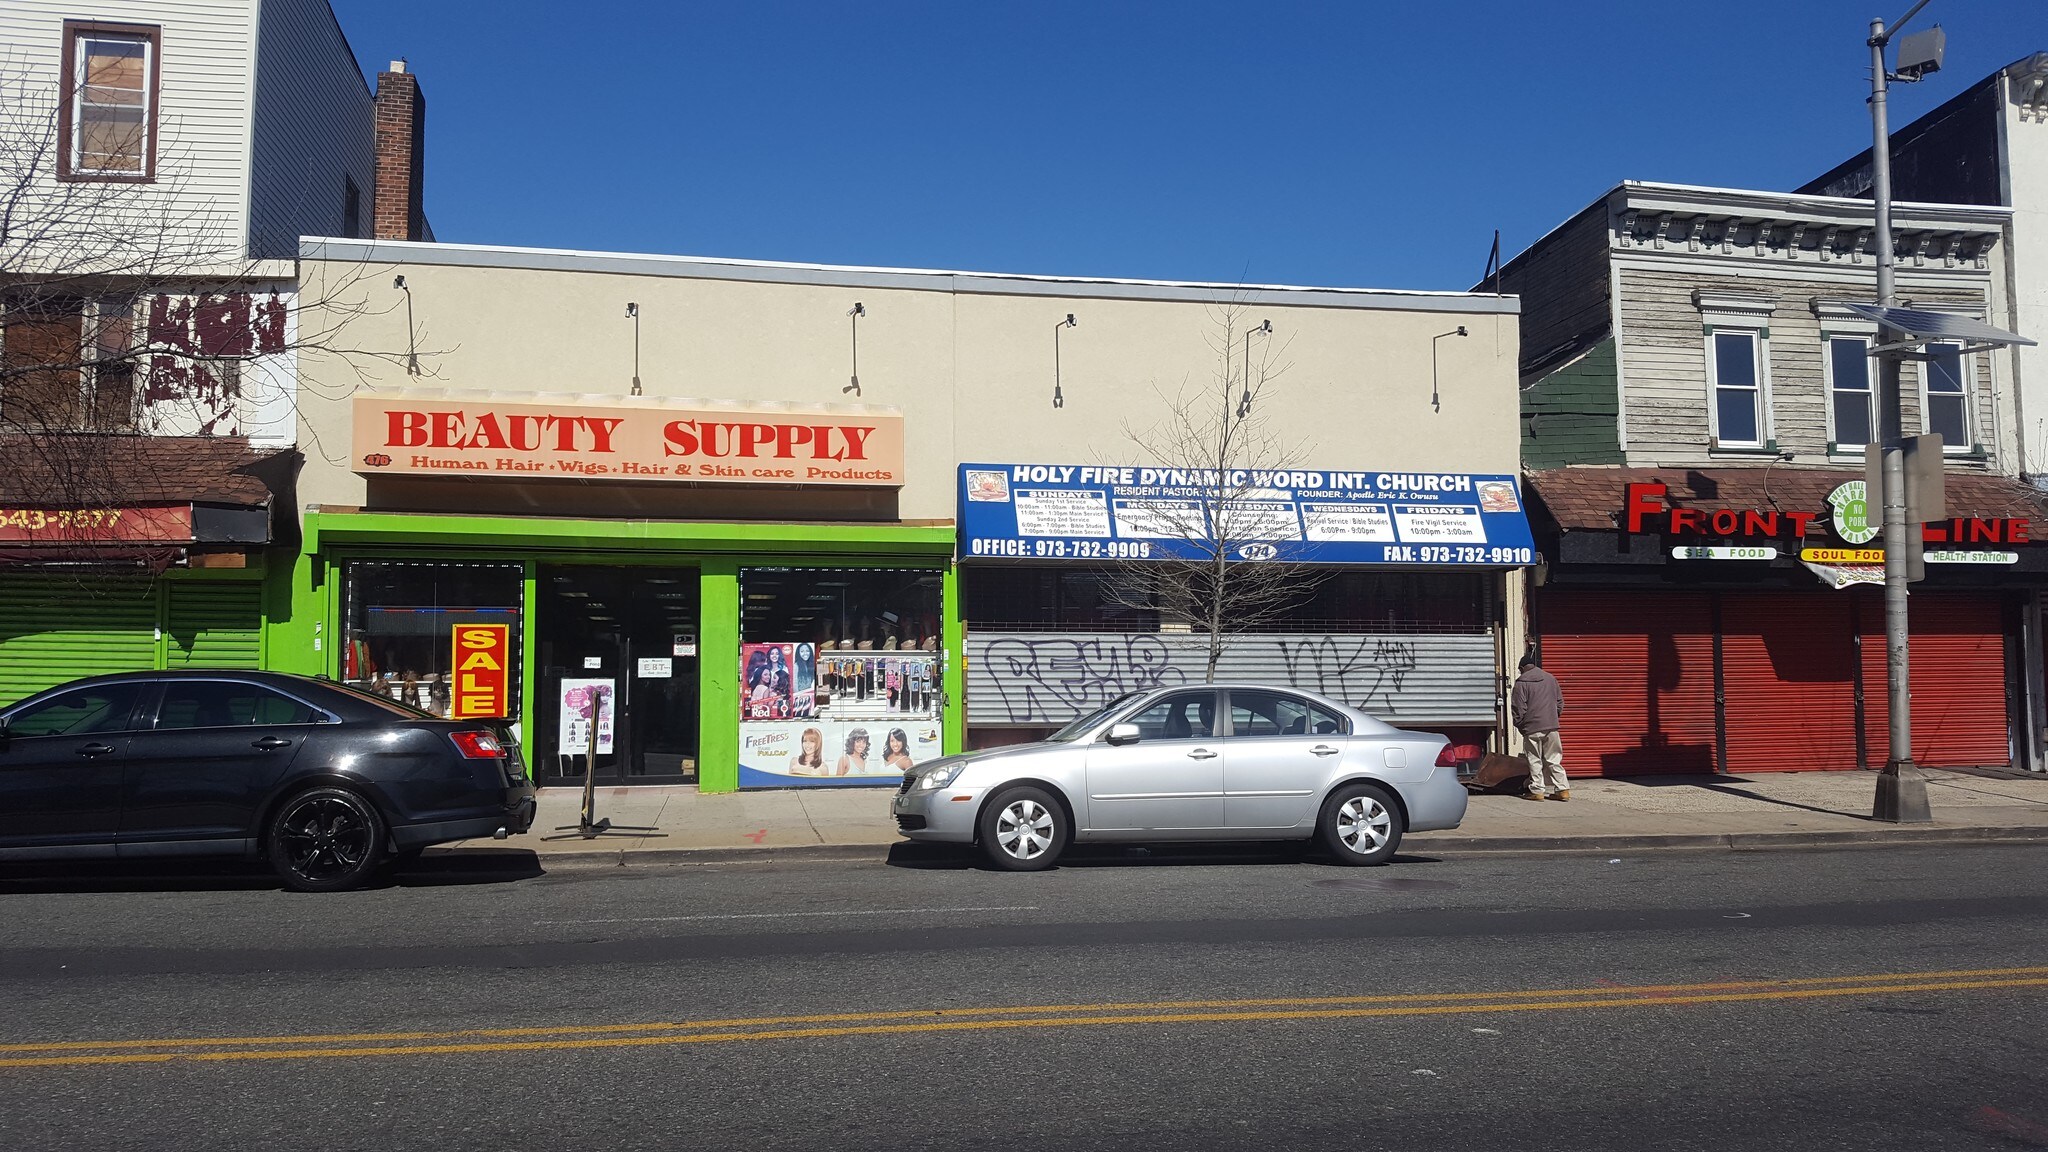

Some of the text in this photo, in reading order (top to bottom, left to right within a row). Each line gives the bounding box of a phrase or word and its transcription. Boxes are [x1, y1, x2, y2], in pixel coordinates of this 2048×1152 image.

[383, 410, 876, 462] BEAUTY SUPPLY
[366, 454, 389, 466] 476
[410, 455, 893, 480] Human Hair Wigs Hair & Skin care Products
[1013, 466, 1471, 492] HOLY FIRE DYNAMIC WORD INT. CHURCH
[1029, 491, 1092, 499] SUNDAYS
[1113, 487, 1160, 496] RESIDENT
[1163, 488, 1203, 497] PASTOR:
[1297, 490, 1344, 498] FOUNDER:
[1346, 491, 1375, 500] Apostle
[1397, 492, 1408, 500] K.
[1126, 502, 1189, 510] MONDAYS
[1222, 503, 1285, 511] TUESDAYS
[1311, 505, 1378, 513] WEDNESDAYS
[1627, 482, 1816, 538] FRONT
[1853, 504, 1863, 515] NO
[1367, 518, 1388, 526] Studies
[1425, 519, 1441, 527] Vigil
[1849, 516, 1867, 527] PORK
[1410, 528, 1441, 536] 10:00pm
[1839, 527, 1875, 543] HALAL
[972, 539, 1151, 558] OFFICE: 973-732-9909
[1684, 547, 1766, 558] SEA FOOD
[1383, 546, 1531, 563] FAX: 973-732-9910
[1812, 550, 1847, 560] SOUL
[1933, 552, 2008, 562] HEALTH STATION
[460, 629, 502, 714] SALE
